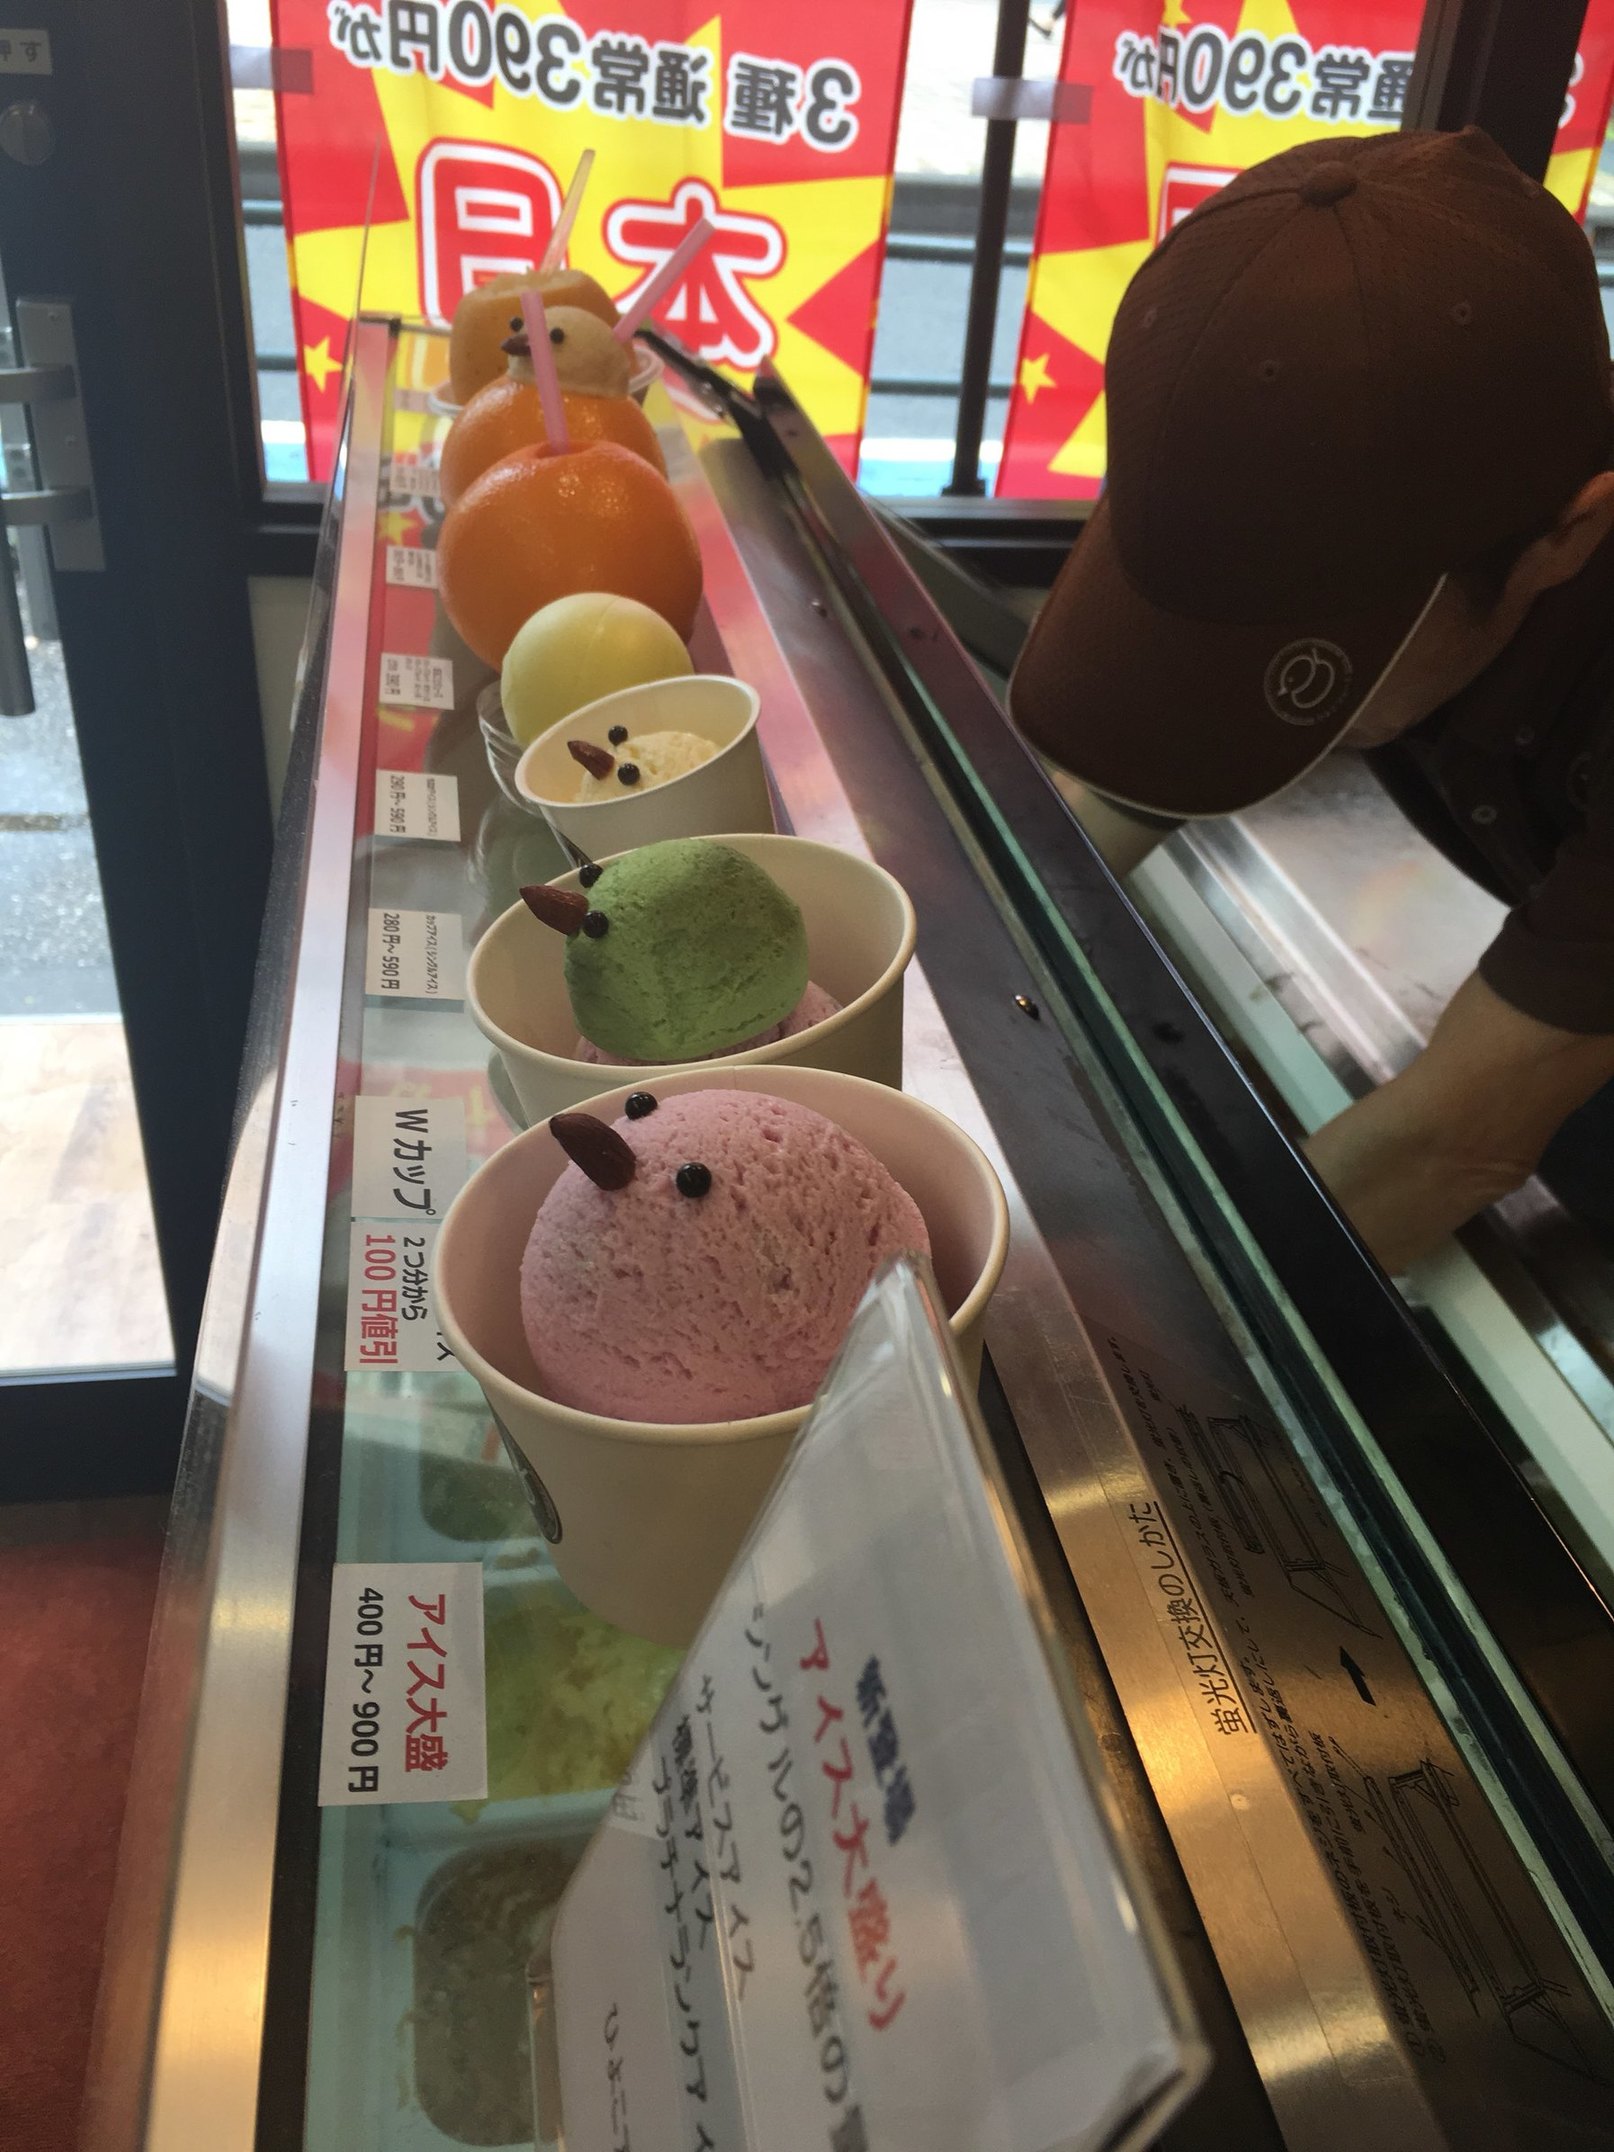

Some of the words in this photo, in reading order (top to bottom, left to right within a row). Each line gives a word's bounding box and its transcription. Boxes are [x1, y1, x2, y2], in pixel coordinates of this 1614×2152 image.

[392, 1108, 437, 1217] Wカップ
[359, 1233, 399, 1364] 100円値引
[401, 1236, 429, 1322] 2つ分から
[404, 1592, 449, 1774] アイス大盛
[1128, 1501, 1250, 1736] 蛍光灯交換のしかた
[800, 1617, 906, 2031] アイス大盛り
